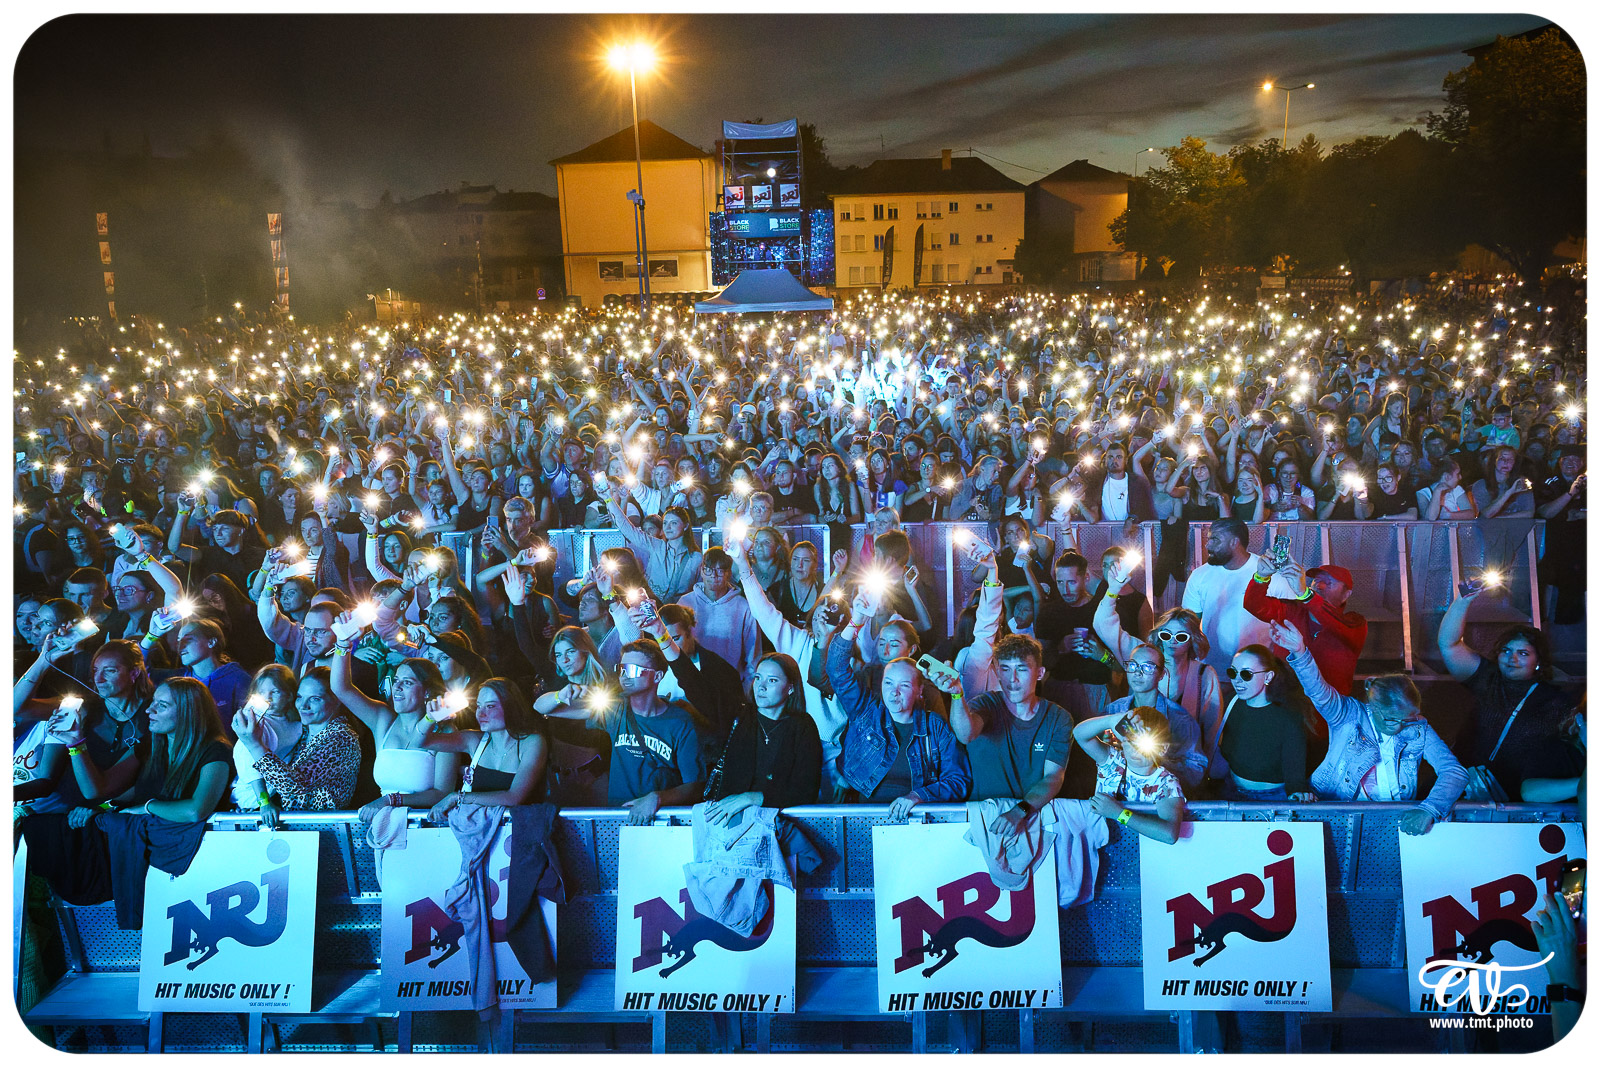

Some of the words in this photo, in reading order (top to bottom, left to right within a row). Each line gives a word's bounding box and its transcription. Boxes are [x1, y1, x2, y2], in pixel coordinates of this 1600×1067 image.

[164, 839, 290, 967] NRJ
[1166, 830, 1297, 963] NRJ
[155, 983, 182, 998] HIT
[184, 983, 236, 999] MUSIC
[240, 983, 281, 999] ONLY
[397, 982, 424, 997] HIT
[427, 980, 472, 997] MUSI
[496, 979, 525, 995] NLY
[1161, 979, 1190, 996] HIT
[1193, 980, 1249, 996] MUSIC
[1253, 980, 1297, 997] ONLY
[623, 992, 654, 1009] HIT
[657, 992, 718, 1010] MUSIC
[723, 993, 770, 1011] ONLY
[888, 993, 919, 1011] HIT
[922, 991, 983, 1010] MUSIC
[989, 990, 1037, 1008] ONLY
[1526, 995, 1551, 1013] ON
